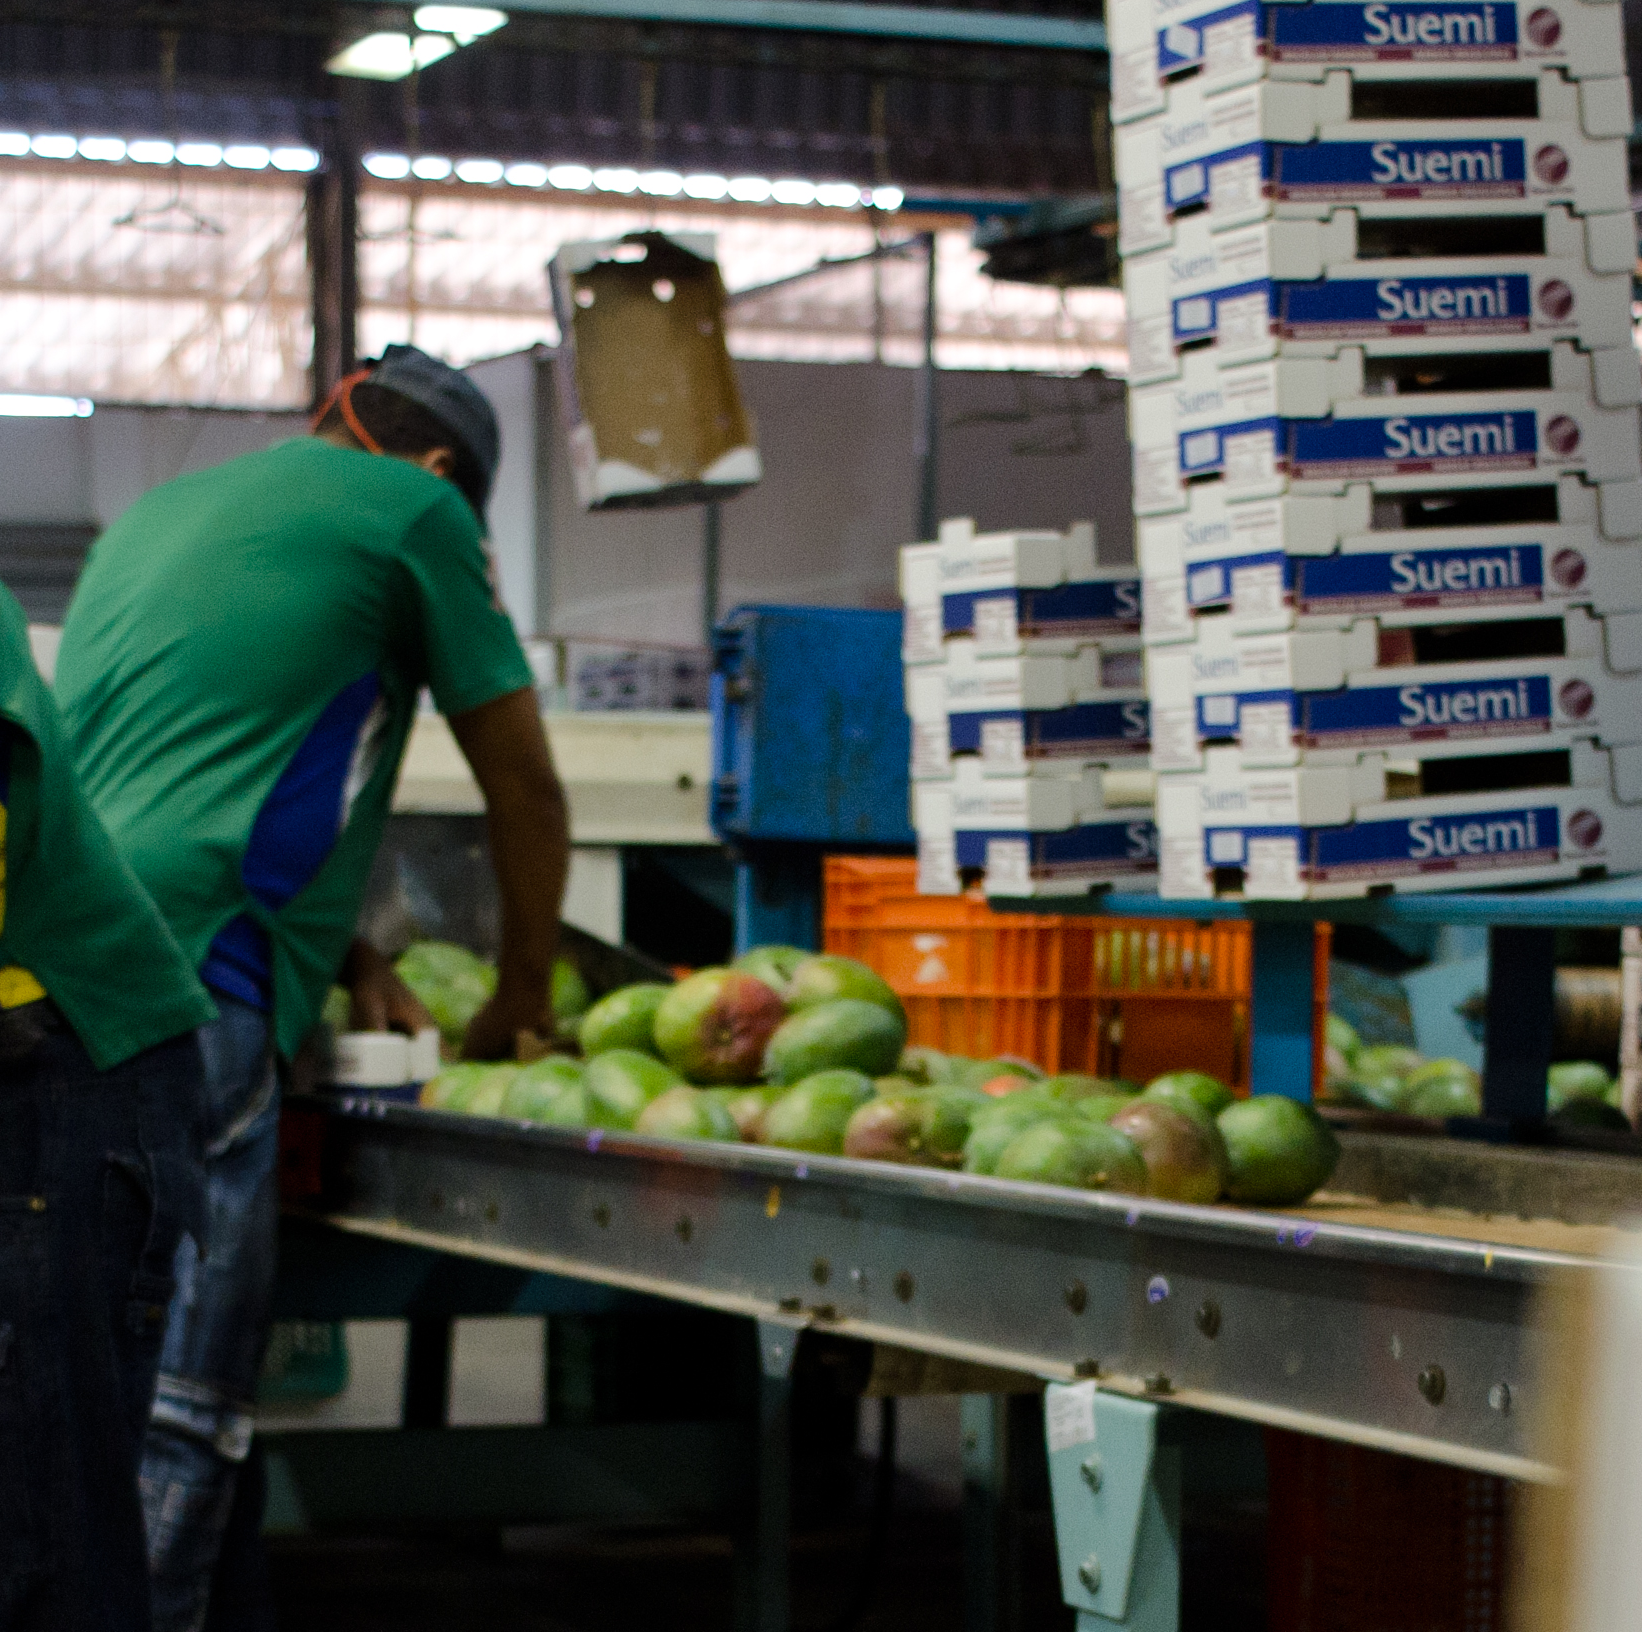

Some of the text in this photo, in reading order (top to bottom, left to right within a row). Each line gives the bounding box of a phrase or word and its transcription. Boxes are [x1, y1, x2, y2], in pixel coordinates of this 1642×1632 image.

[1364, 4, 1497, 47] Suemi
[1370, 142, 1504, 184] Suemi
[1377, 279, 1509, 321] Suemi
[1383, 415, 1515, 459] Suemi
[1390, 548, 1522, 594] Suemi
[1399, 680, 1530, 727] Suemi
[1407, 812, 1539, 859] Suemi
